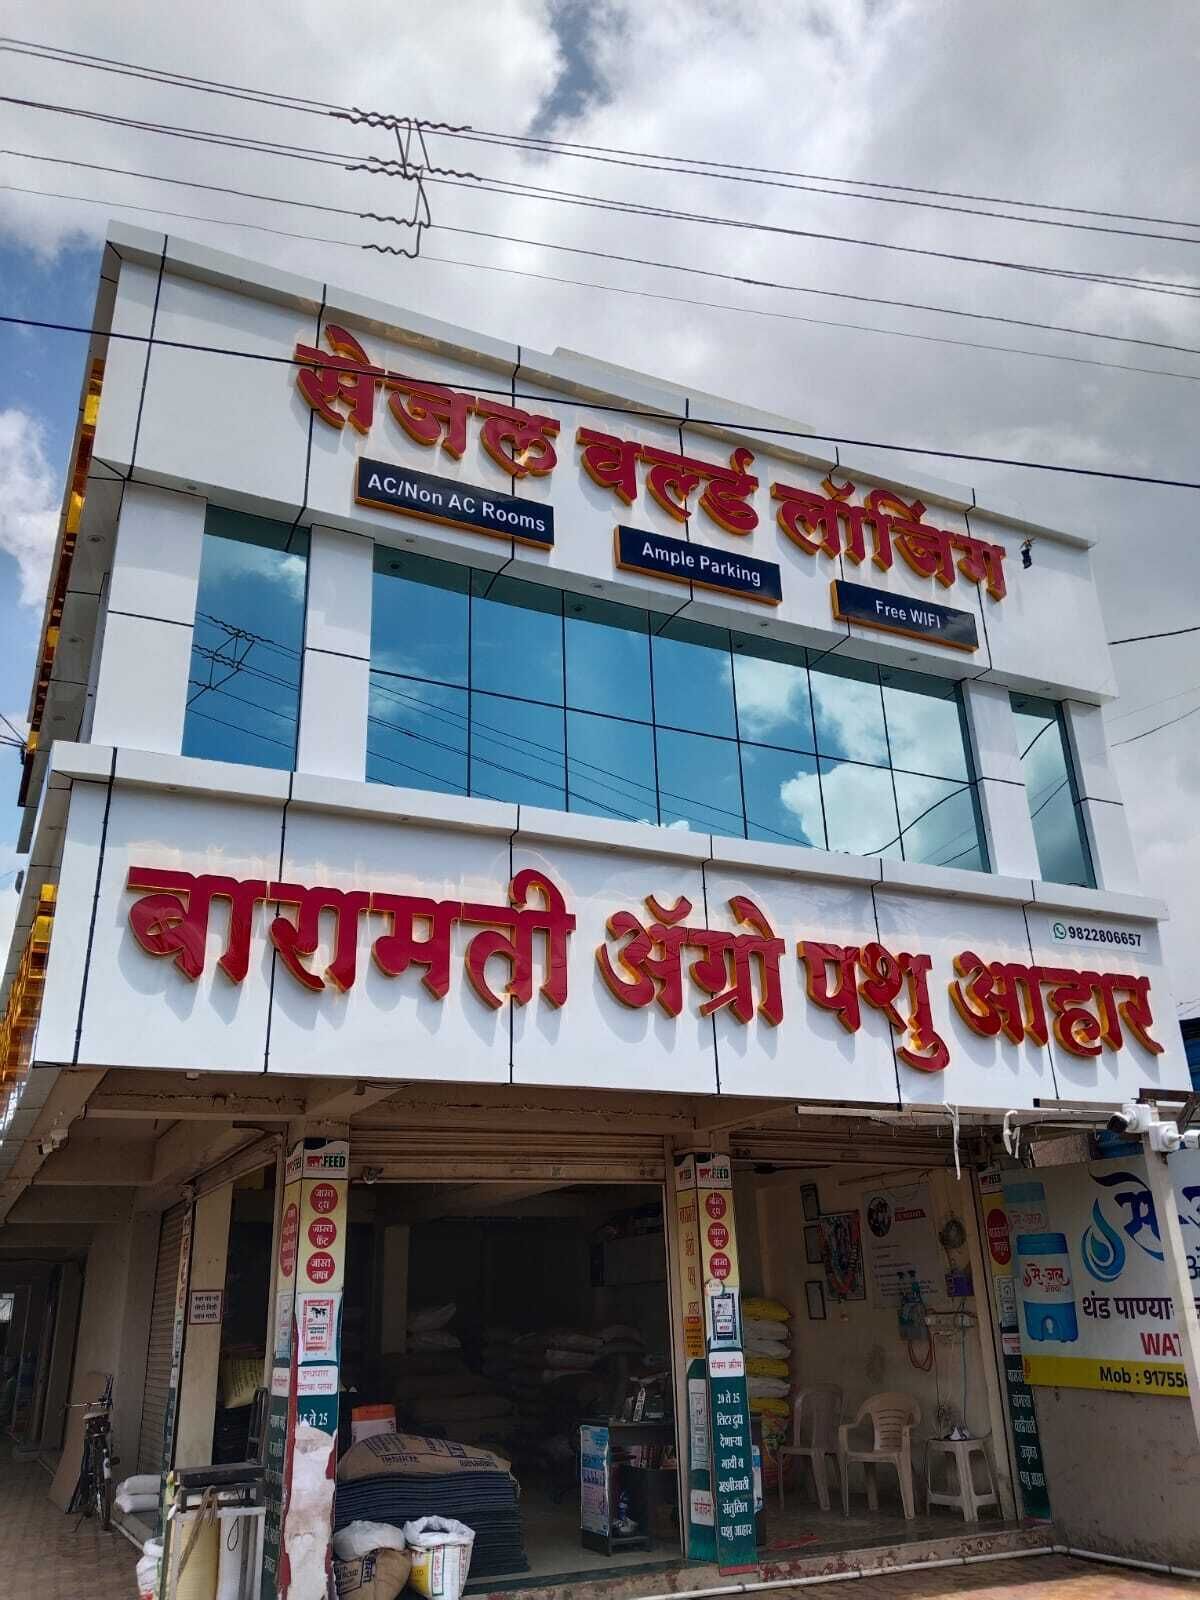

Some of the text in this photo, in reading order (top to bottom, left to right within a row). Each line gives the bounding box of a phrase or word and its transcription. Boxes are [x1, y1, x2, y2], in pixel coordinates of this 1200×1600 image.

[294, 324, 560, 479] सेजल
[367, 473, 546, 533] AC/Non AC Rooms
[641, 541, 762, 588] Ample Parking
[875, 599, 941, 629] Free WIFI
[1068, 925, 1141, 947] 9822806657
[127, 866, 576, 1010] बारामती
[798, 940, 950, 1074] पशु
[949, 950, 1165, 1057] आहार
[1083, 1291, 1111, 1320] थंड
[1114, 1296, 1175, 1321] पाण्या
[1100, 1366, 1131, 1384] Mob
